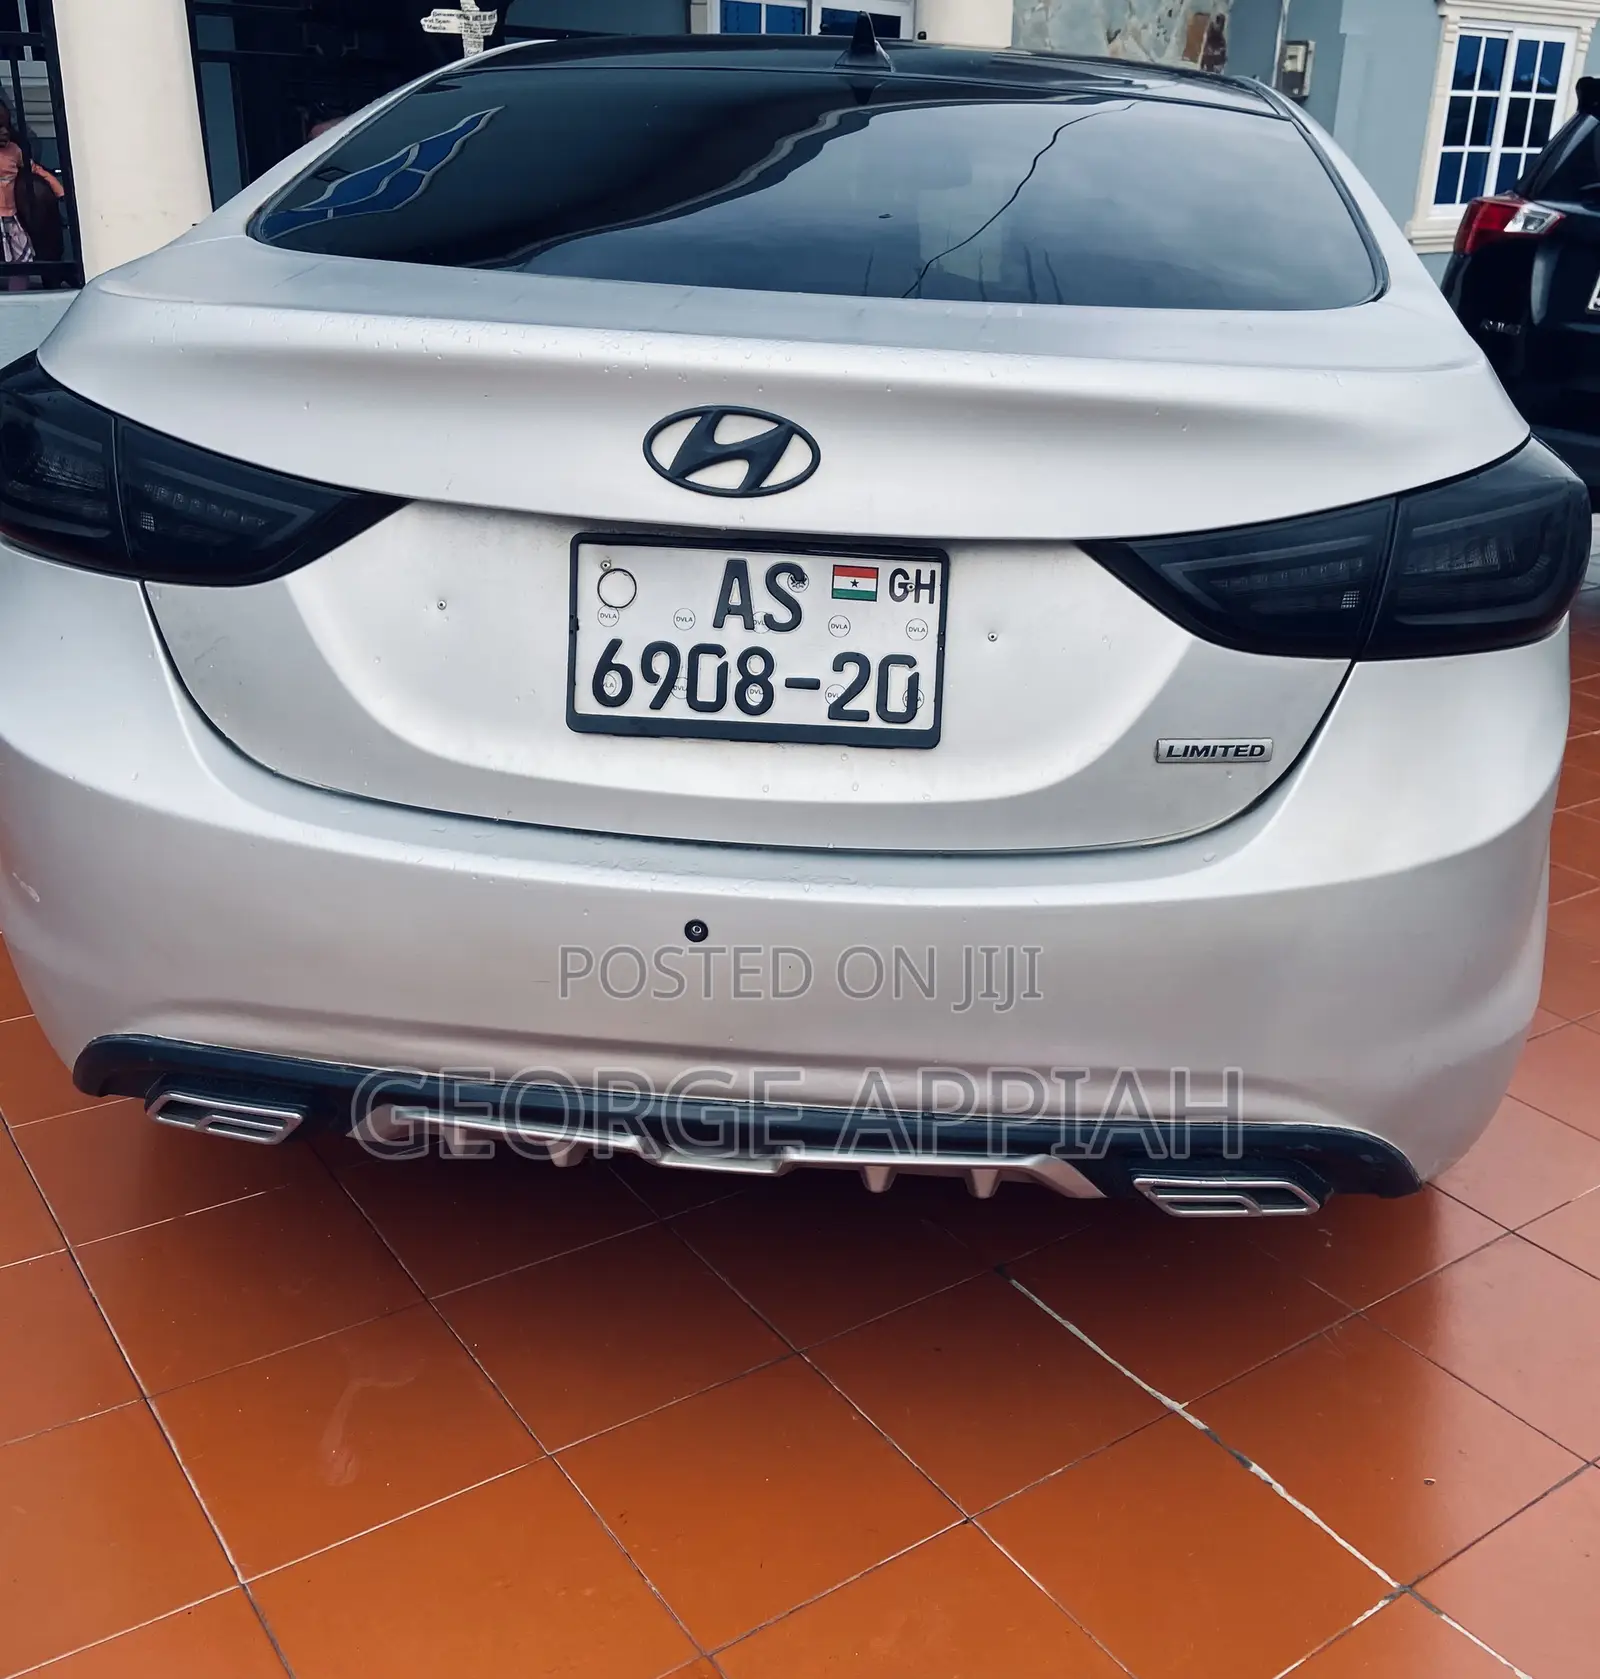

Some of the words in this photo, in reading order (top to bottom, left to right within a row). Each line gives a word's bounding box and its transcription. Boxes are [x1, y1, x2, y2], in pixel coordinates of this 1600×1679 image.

[713, 559, 802, 632] AS
[889, 567, 936, 604] GH
[600, 612, 617, 620] DVLA
[592, 638, 920, 723] 6908-20
[1166, 744, 1265, 758] LIMITED
